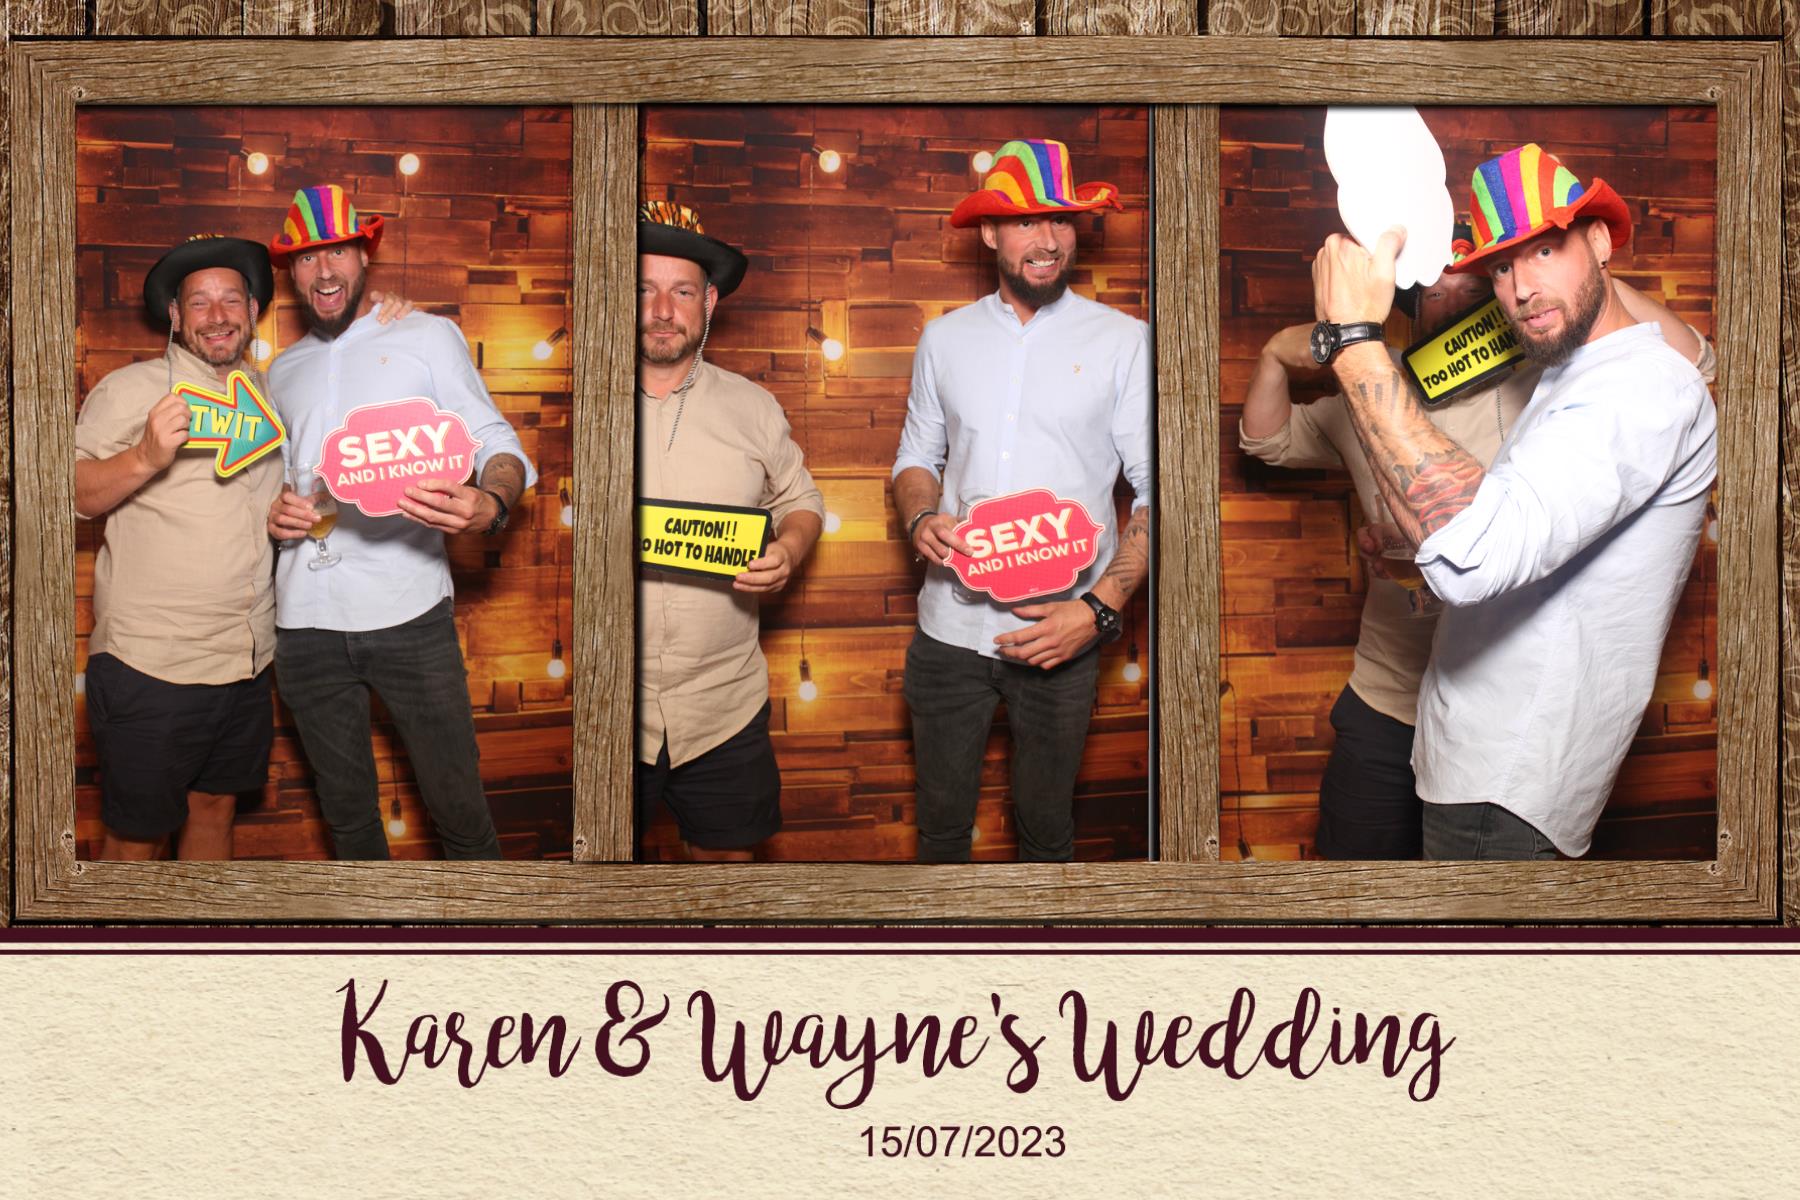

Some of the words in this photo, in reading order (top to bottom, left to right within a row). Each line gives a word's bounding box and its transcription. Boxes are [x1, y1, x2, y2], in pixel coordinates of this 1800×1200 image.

[1444, 306, 1507, 356] CAUTION!!
[1423, 369, 1448, 389] TOO
[1447, 354, 1472, 377] HOT
[1471, 346, 1489, 364] TO
[1488, 329, 1519, 356] HAN
[190, 404, 263, 441] TWIT
[338, 421, 451, 468] SEXY
[336, 465, 375, 486] AND
[380, 465, 385, 480] I
[388, 456, 444, 478] KNOW
[449, 454, 464, 469] IT
[664, 517, 738, 542] CAUTION!!
[965, 508, 1073, 558] SEXY
[654, 538, 683, 557] HOT
[685, 542, 703, 560] TO
[704, 545, 757, 567] HANDLE
[967, 557, 1004, 577] AND
[1007, 555, 1013, 568] I
[1016, 543, 1070, 566] KNOW
[1073, 538, 1088, 554] IT
